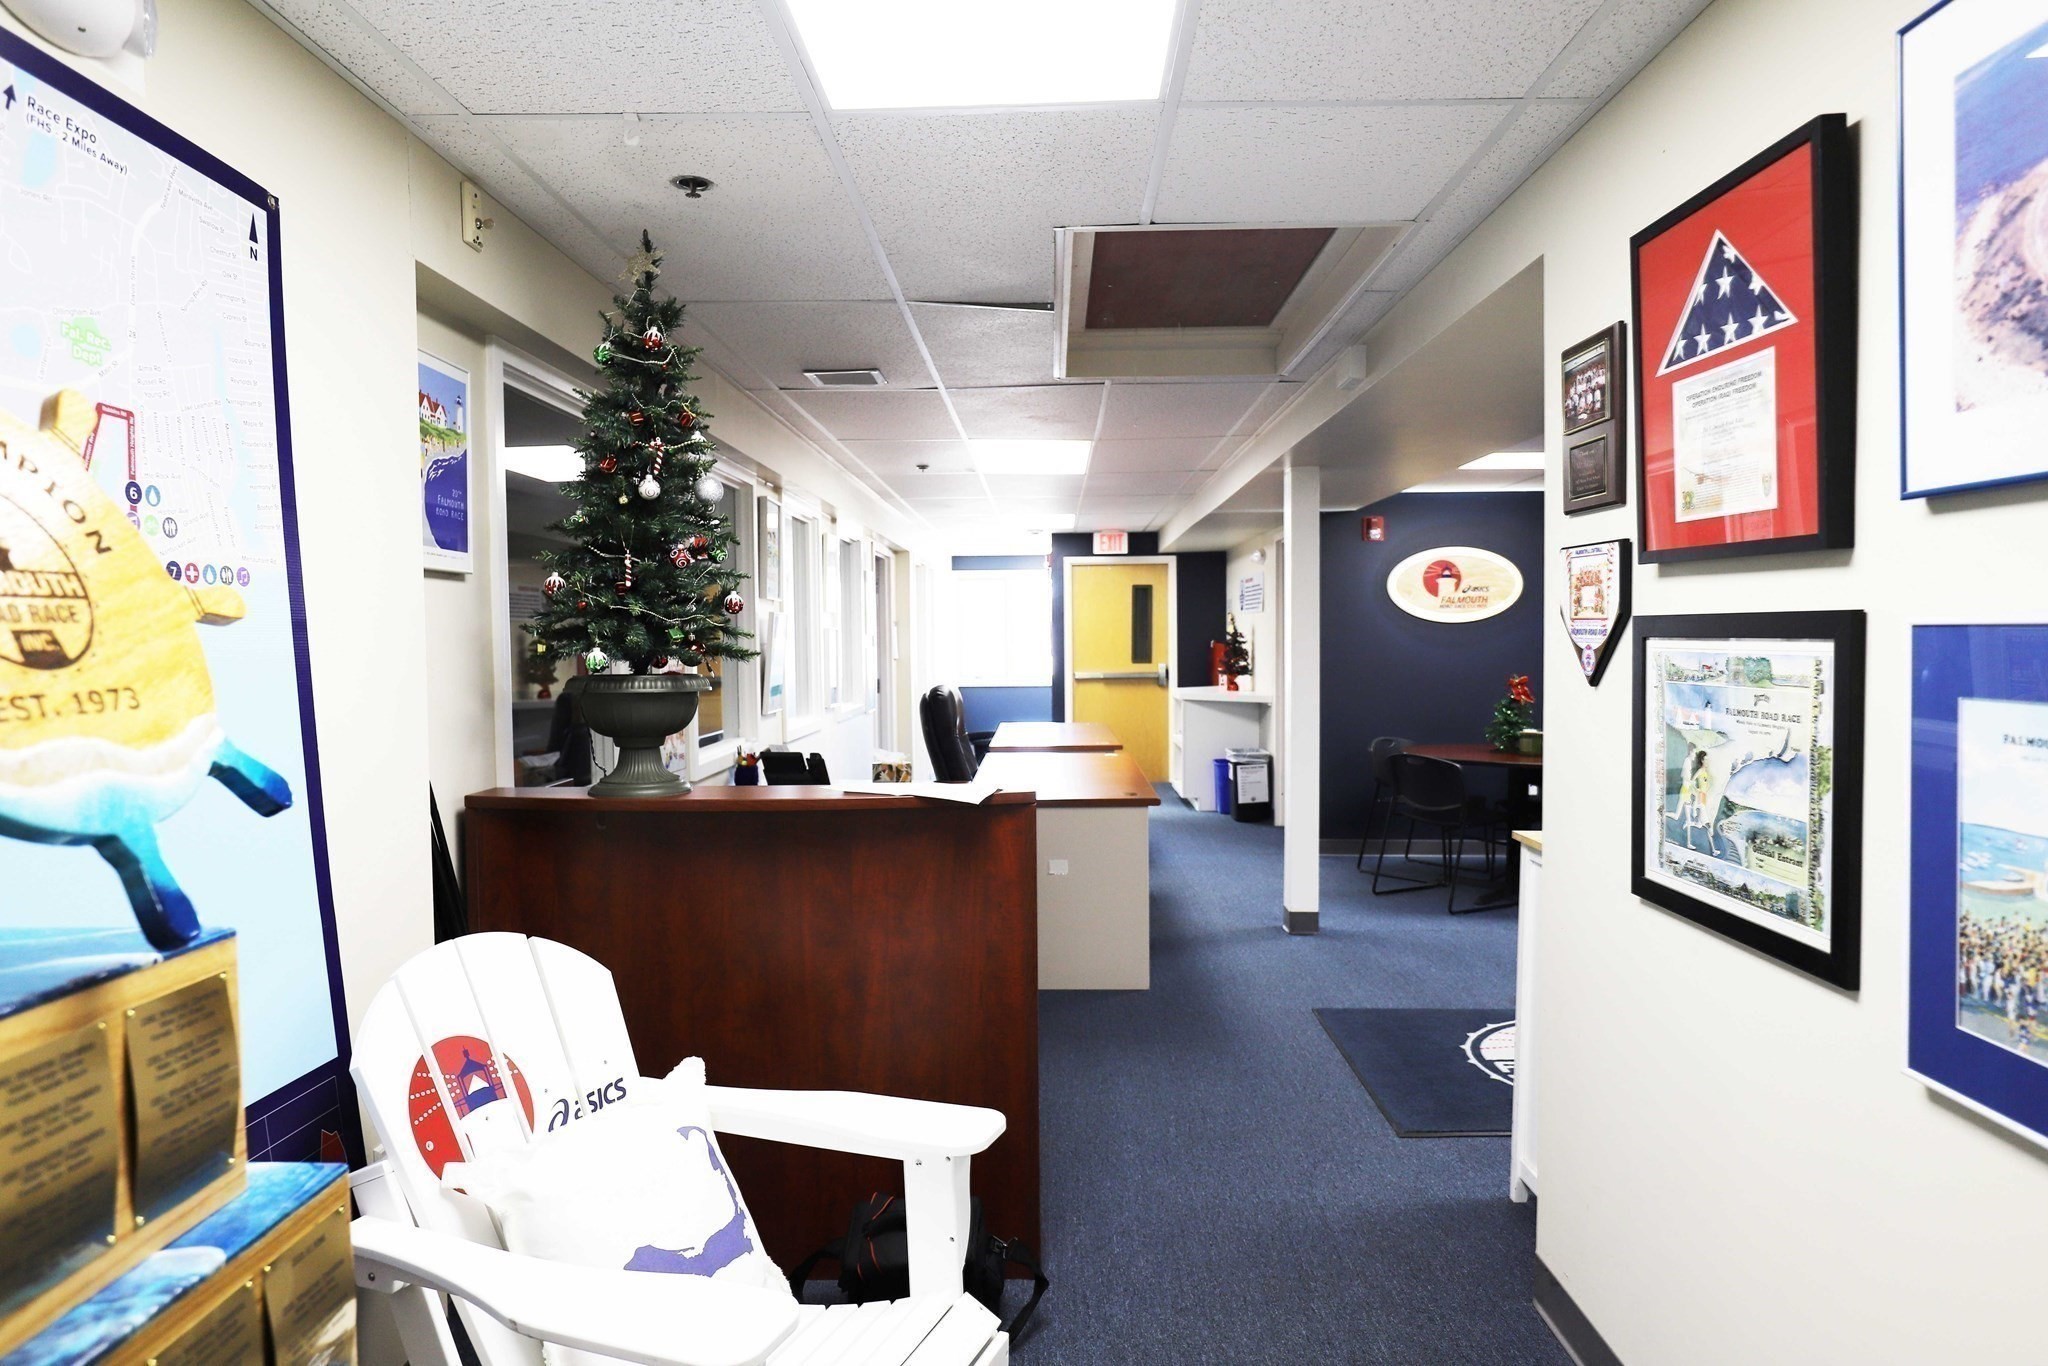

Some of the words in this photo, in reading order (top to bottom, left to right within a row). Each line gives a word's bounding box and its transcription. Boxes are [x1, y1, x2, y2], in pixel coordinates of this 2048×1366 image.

[27, 96, 61, 124] Race
[66, 117, 97, 144] Expo
[26, 113, 53, 134] (FHS
[62, 131, 69, 143] 2
[72, 137, 98, 158] Miles
[100, 153, 128, 176] Away)
[249, 246, 258, 262] N
[61, 321, 84, 343] Fal.
[85, 331, 111, 353] Rec.
[1685, 388, 1711, 402] OPERATION
[1711, 378, 1737, 393] ENDURING
[1737, 370, 1762, 384] FREEDOM
[1691, 395, 1718, 409] OPERATION
[1732, 382, 1757, 395] FREEDOM
[129, 487, 138, 500] 6
[437, 494, 465, 510] FALMOUTH
[435, 506, 449, 517] ROAD
[450, 510, 465, 521] RACE
[1100, 534, 1123, 552] EXIT
[169, 566, 178, 579] 7
[1440, 595, 1489, 604] FALMOUTH
[28, 604, 80, 623] RACE
[72, 687, 140, 714] 1973
[1725, 707, 1759, 719] FALMOUTH
[1760, 711, 1779, 721] ROAD
[1781, 713, 1801, 724] RACE
[1752, 844, 1775, 859] Official
[1777, 852, 1803, 868] Entrant
